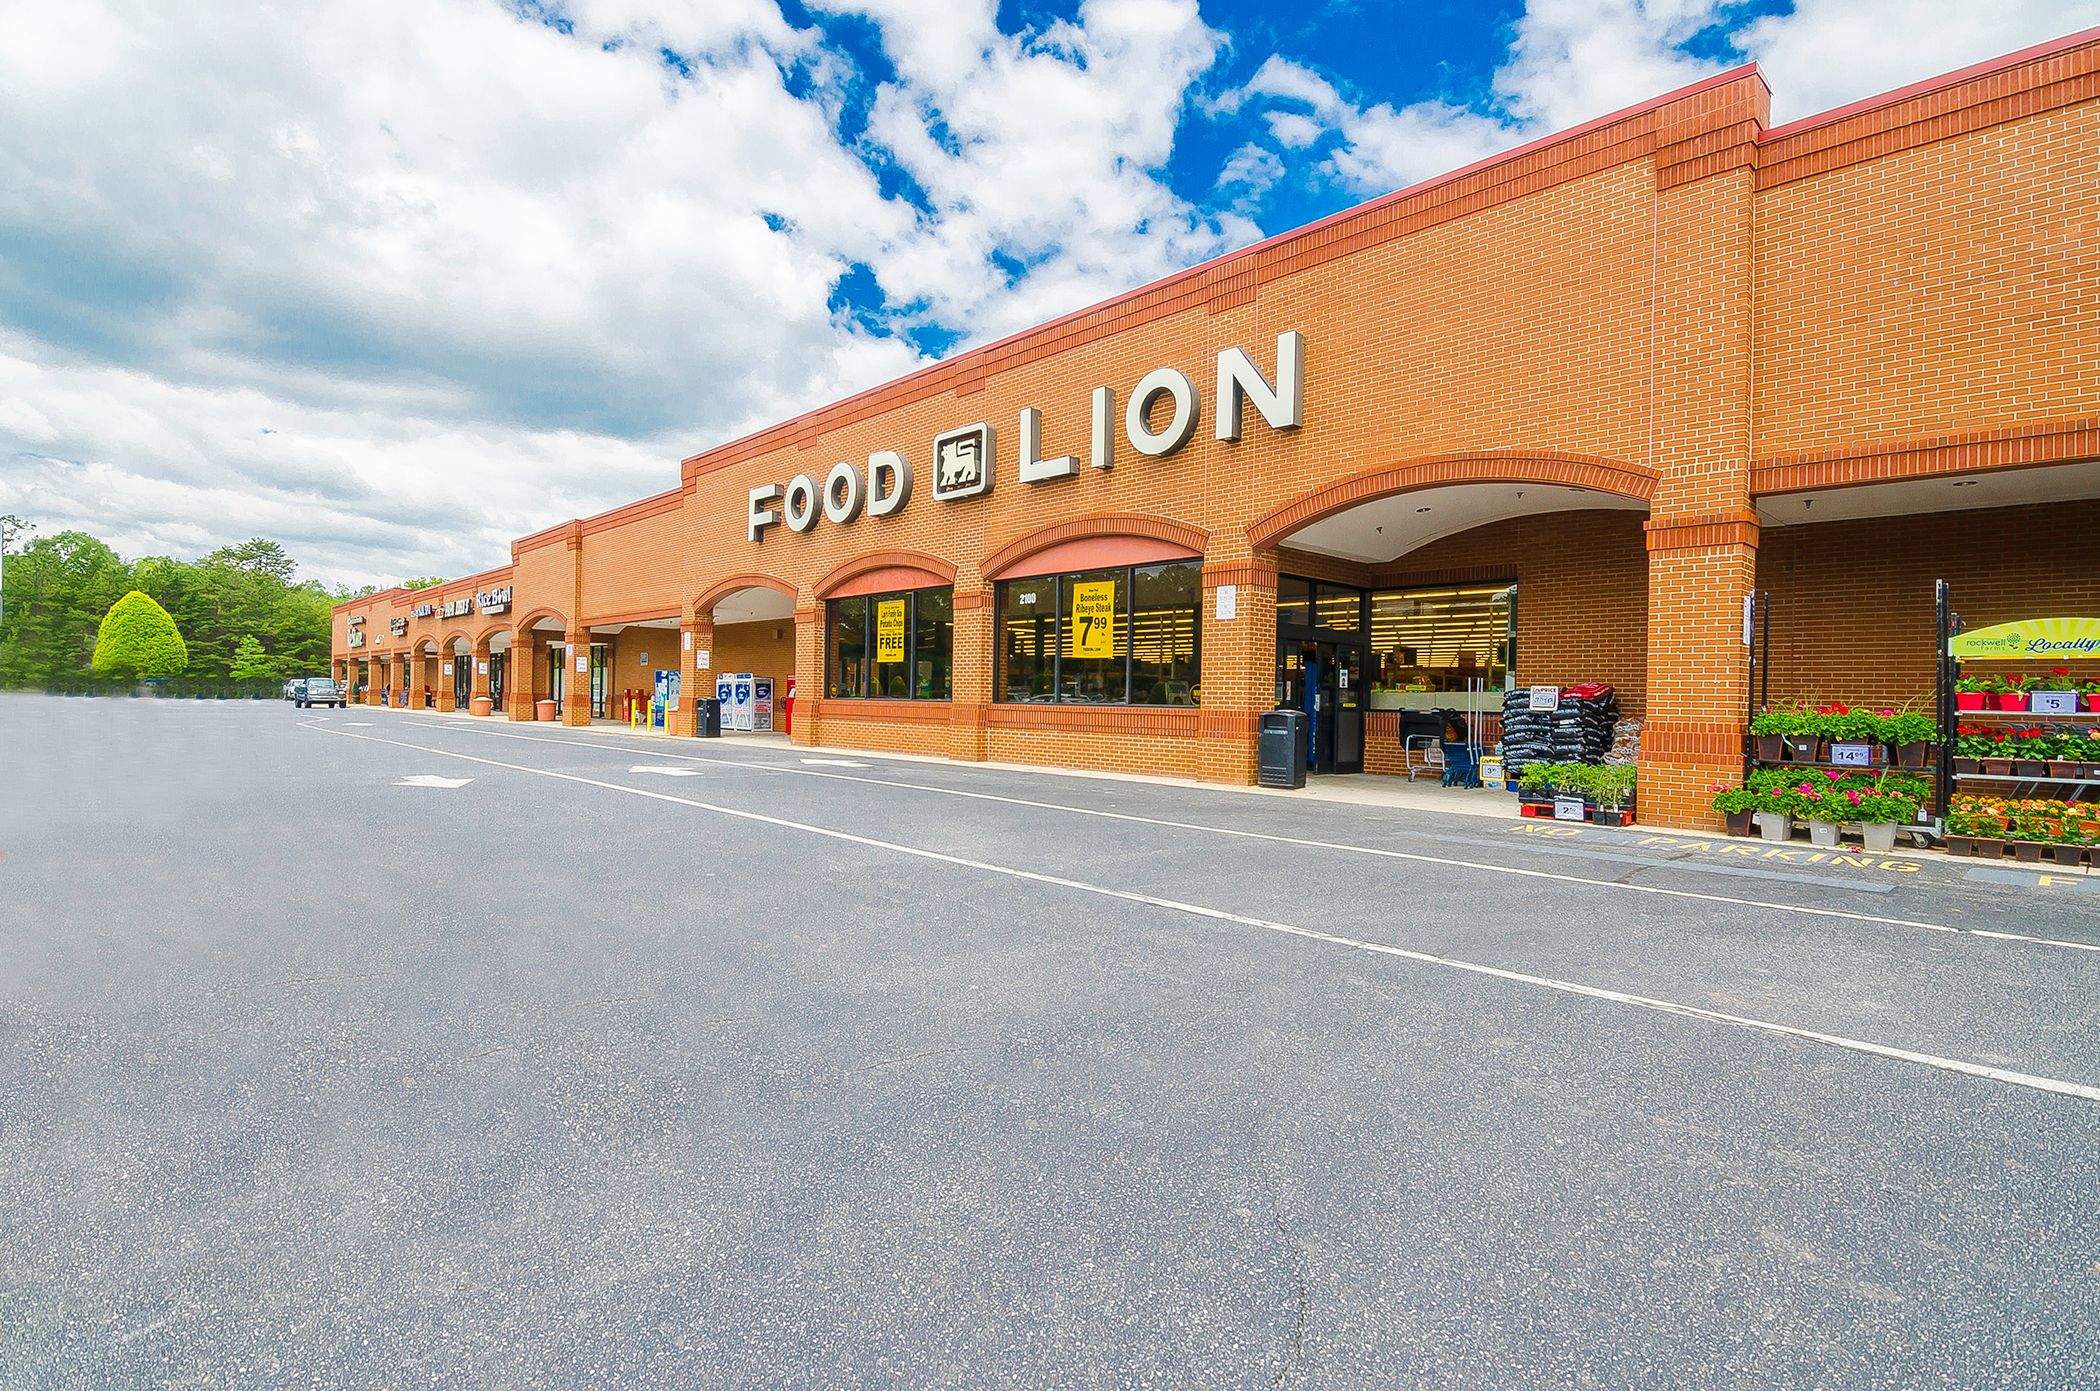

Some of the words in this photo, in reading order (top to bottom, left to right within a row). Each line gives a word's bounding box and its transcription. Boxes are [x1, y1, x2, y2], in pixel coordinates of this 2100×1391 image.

[747, 450, 913, 543] FOOD
[1018, 329, 1305, 485] LION
[1019, 592, 1037, 605] 2100
[1080, 593, 1108, 602] Boneless
[1076, 603, 1094, 615] Ribeye
[1095, 602, 1111, 613] Steak
[880, 636, 903, 649] FREE
[1966, 639, 2006, 647] rockwell
[2025, 637, 2100, 654] Locally
[1509, 823, 1583, 837] NO
[1637, 836, 1923, 874] PARKING
